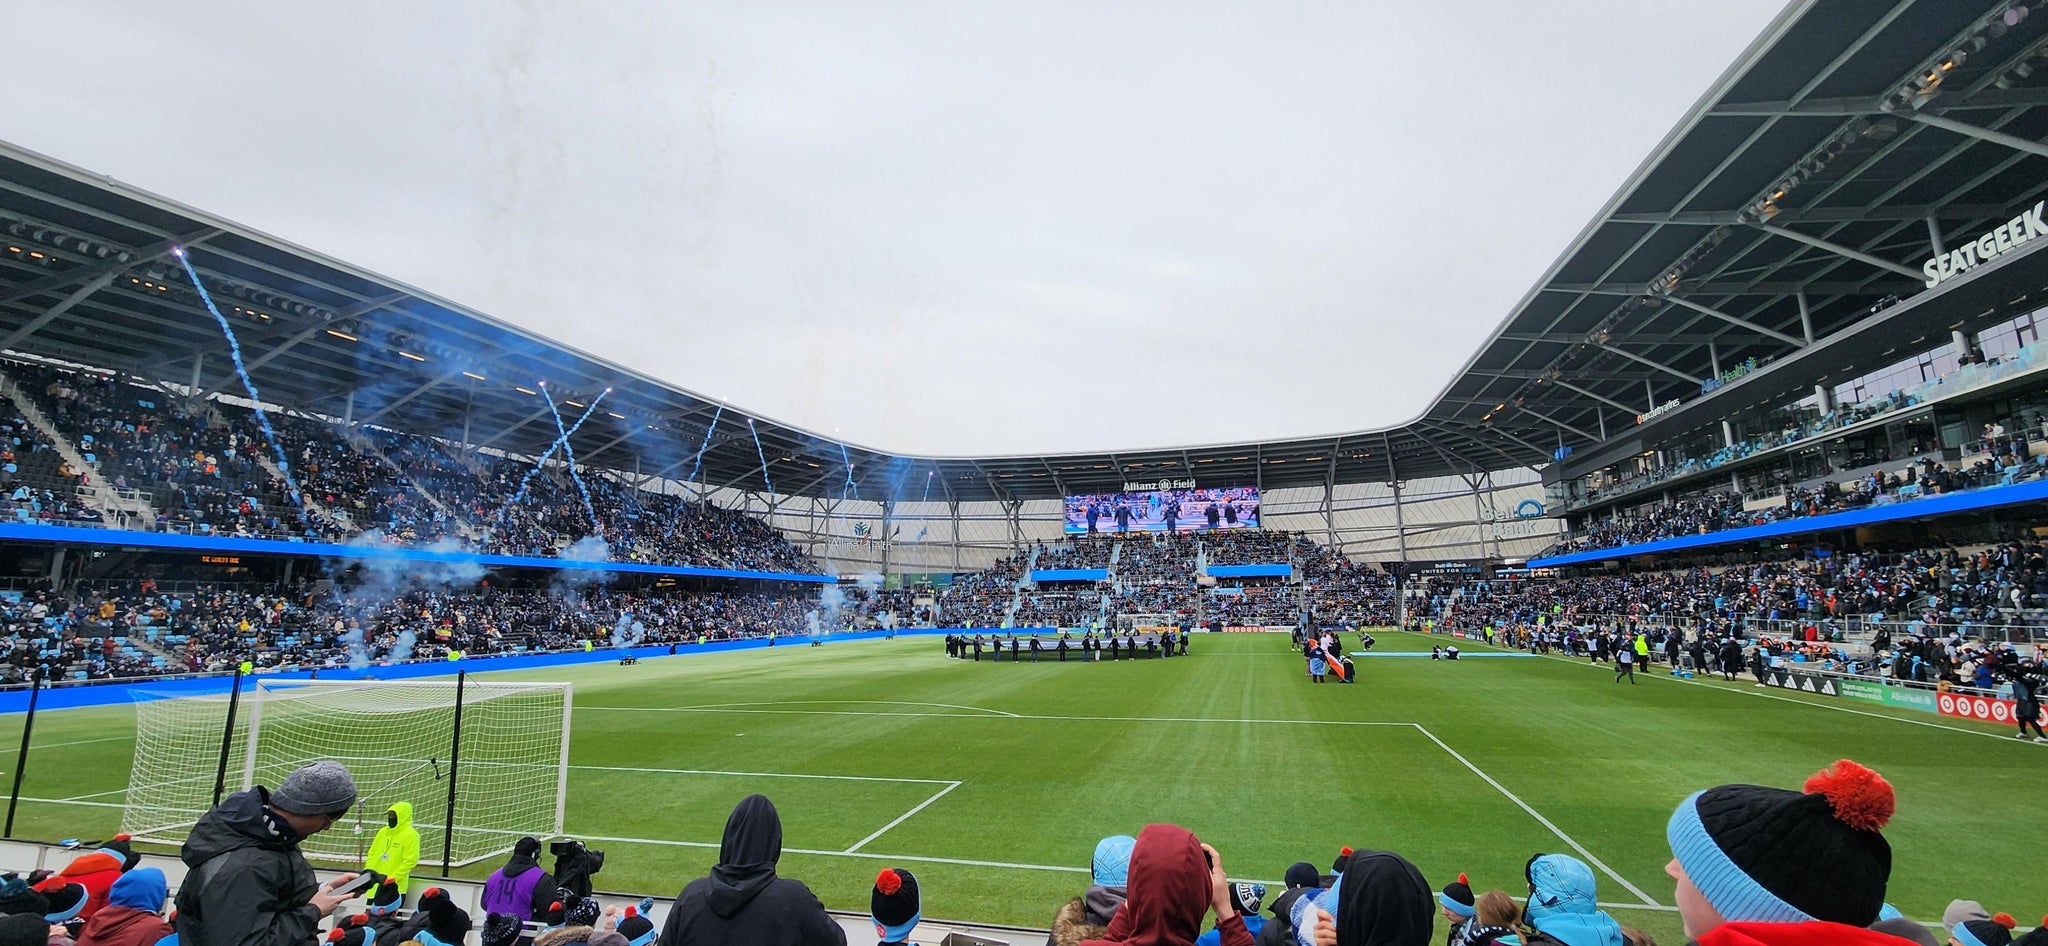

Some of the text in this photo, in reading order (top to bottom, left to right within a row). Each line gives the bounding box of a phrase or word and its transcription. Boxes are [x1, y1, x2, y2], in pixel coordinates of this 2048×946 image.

[1923, 200, 2048, 289] SEATGEEK
[1123, 479, 1196, 491] Allianz Field
[1484, 505, 1516, 520] Bell
[1493, 517, 1536, 536] Bank
[497, 878, 518, 905] 14
